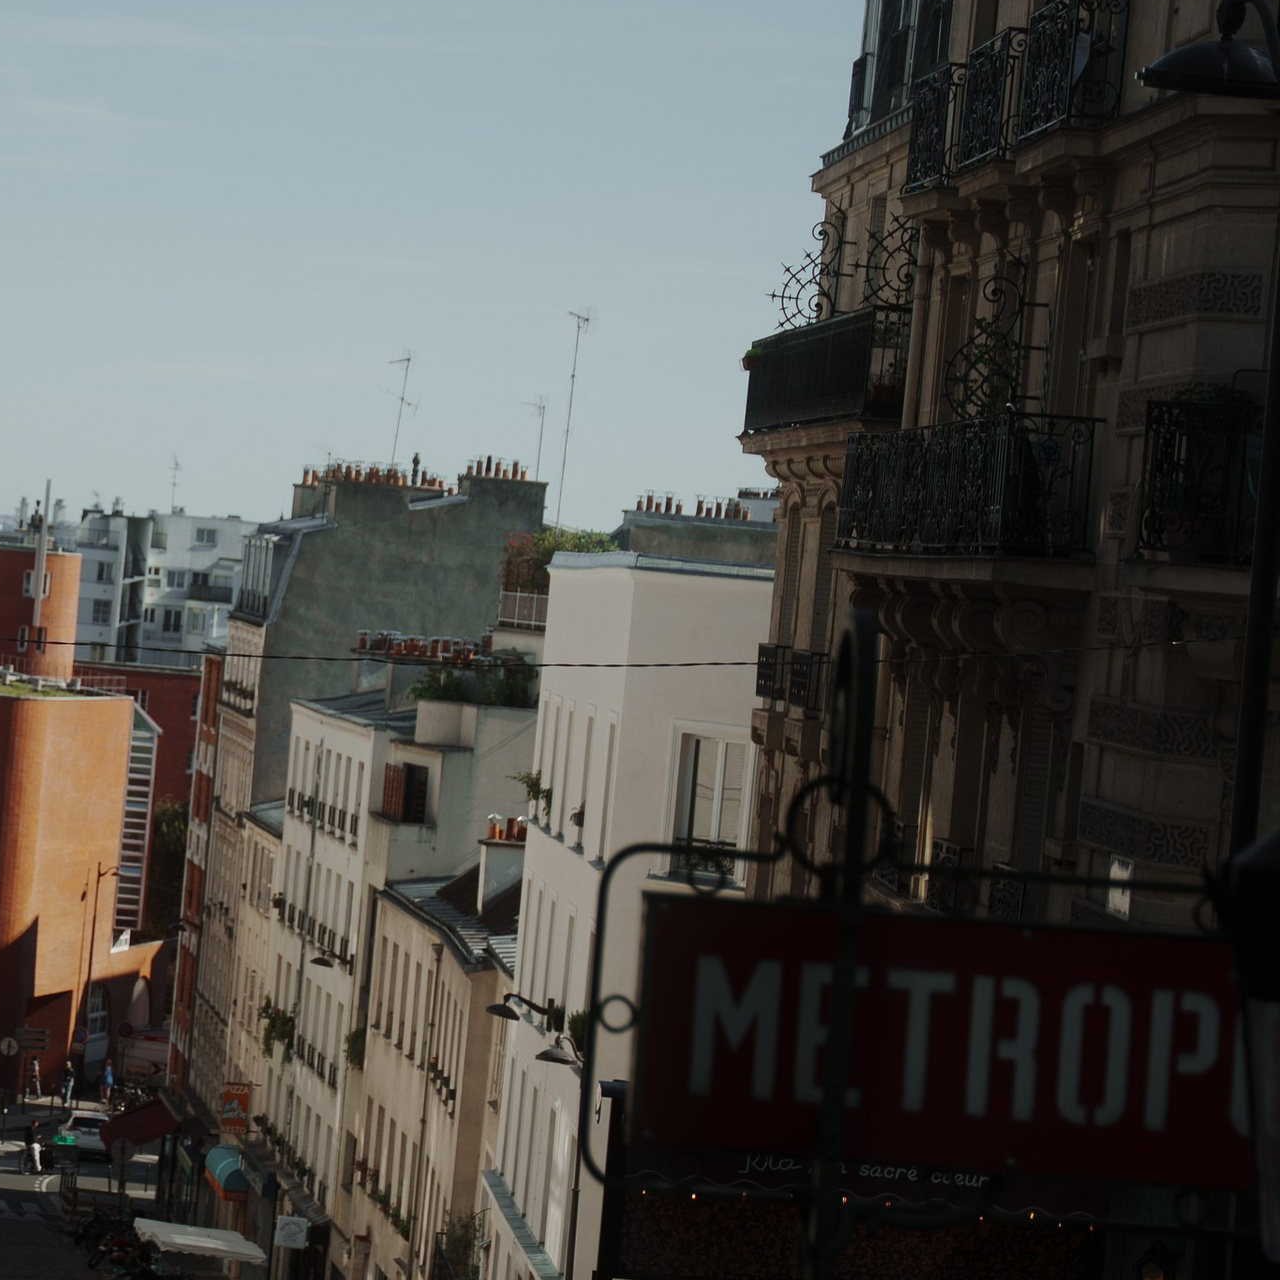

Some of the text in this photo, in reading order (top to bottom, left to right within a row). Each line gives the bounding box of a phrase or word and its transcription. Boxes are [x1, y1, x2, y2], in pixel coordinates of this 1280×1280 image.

[687, 952, 1250, 1139] METROP
[224, 1084, 250, 1095] PIZZA
[221, 1125, 246, 1134] RESTO
[859, 1164, 918, 1181] sacré
